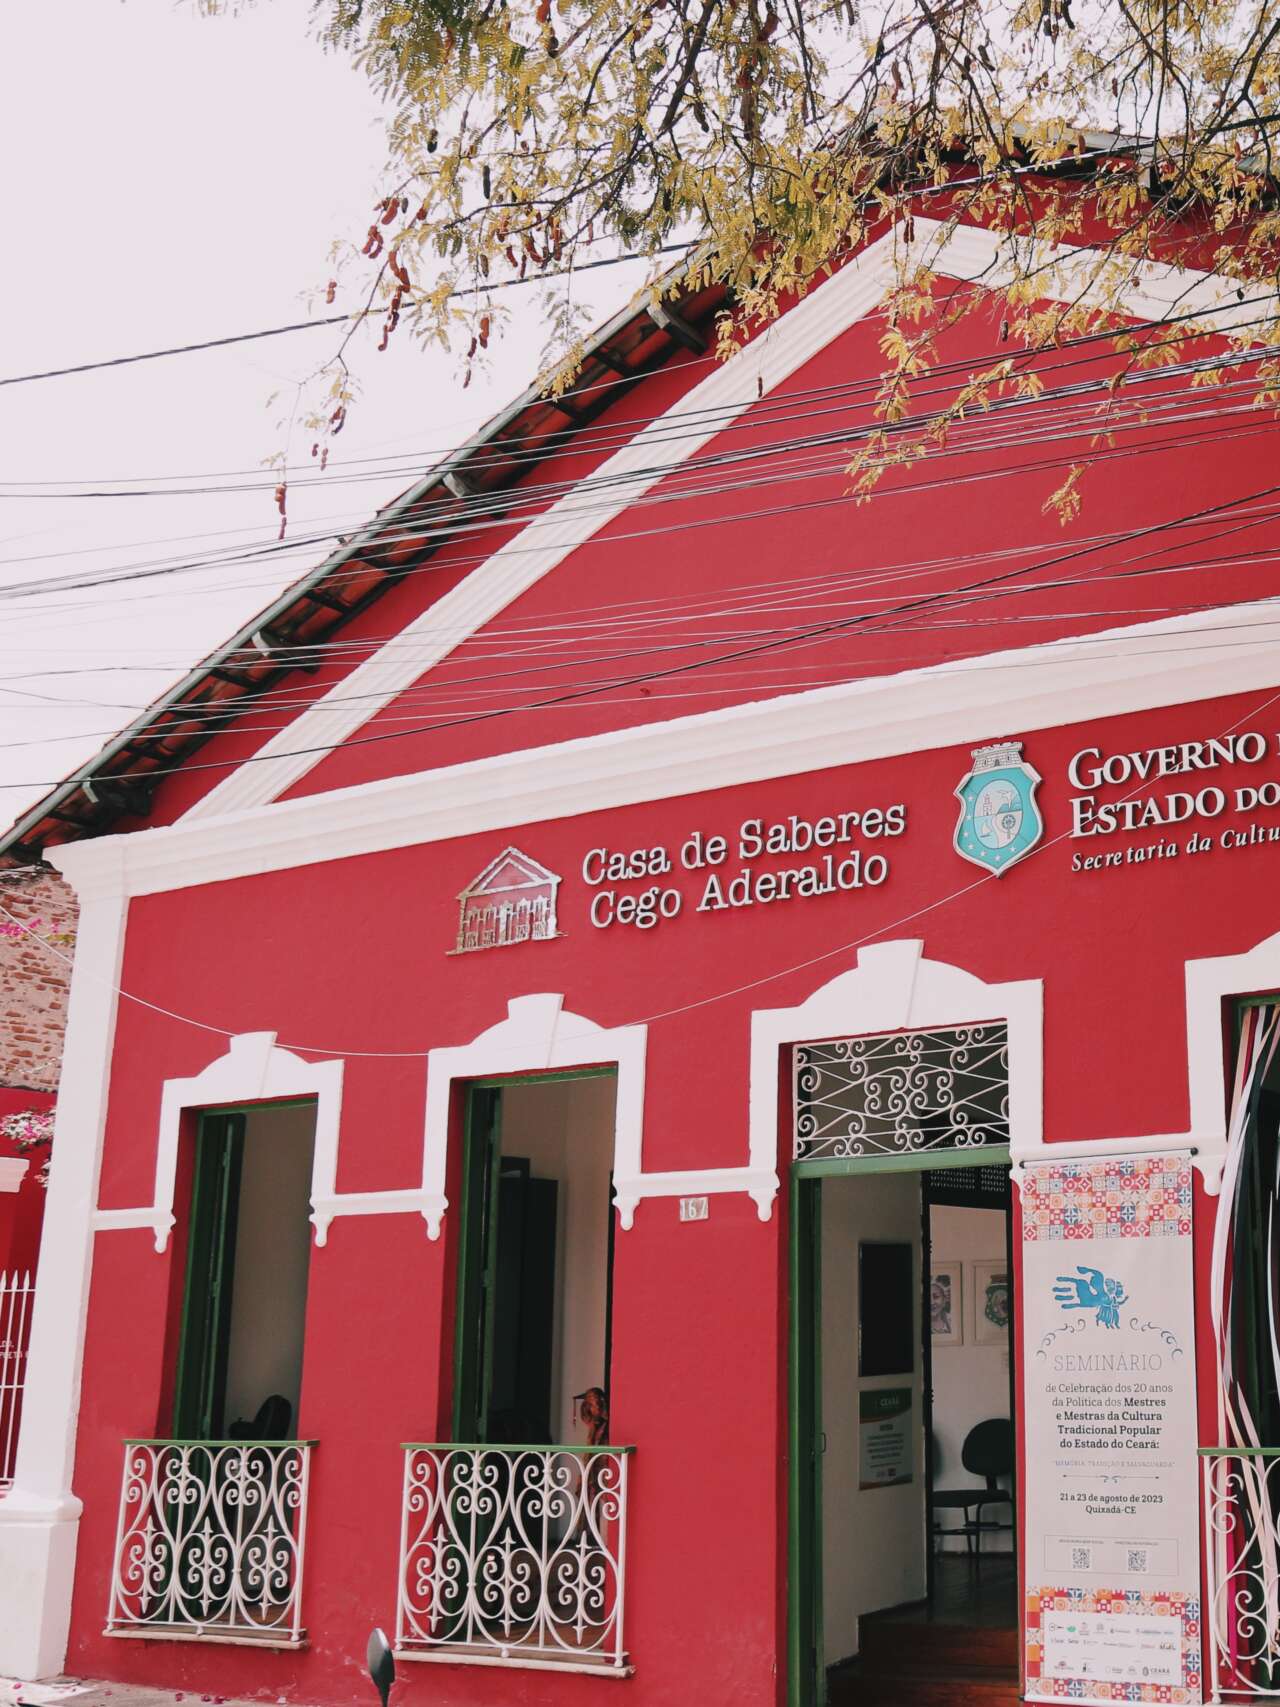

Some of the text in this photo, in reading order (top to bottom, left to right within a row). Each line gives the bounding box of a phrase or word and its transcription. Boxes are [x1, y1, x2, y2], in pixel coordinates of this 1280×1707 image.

[1069, 732, 1265, 790] GOVERNO
[1069, 788, 1225, 838] ESTADO
[583, 804, 906, 886] Casa de Saberes
[1071, 844, 1178, 872] Secretaria
[1186, 833, 1211, 854] da
[590, 851, 889, 929] Cego Aderaldo
[682, 1199, 707, 1218] 167
[1054, 1352, 1162, 1371] SEMINÁRIO
[1046, 1383, 1173, 1394] de Celebração dos 20 anos
[1052, 1397, 1063, 1407] da
[1105, 1397, 1122, 1407] dos
[1124, 1397, 1166, 1407] Mestres
[1064, 1411, 1105, 1421] Mestras
[1107, 1411, 1120, 1421] da
[1122, 1411, 1162, 1421] Cultura
[1058, 1425, 1161, 1437] Tradicional Popular
[1060, 1439, 1159, 1449] do Estado do Ceará:
[1100, 1495, 1128, 1503] agosto
[1142, 1495, 1163, 1503] 2023
